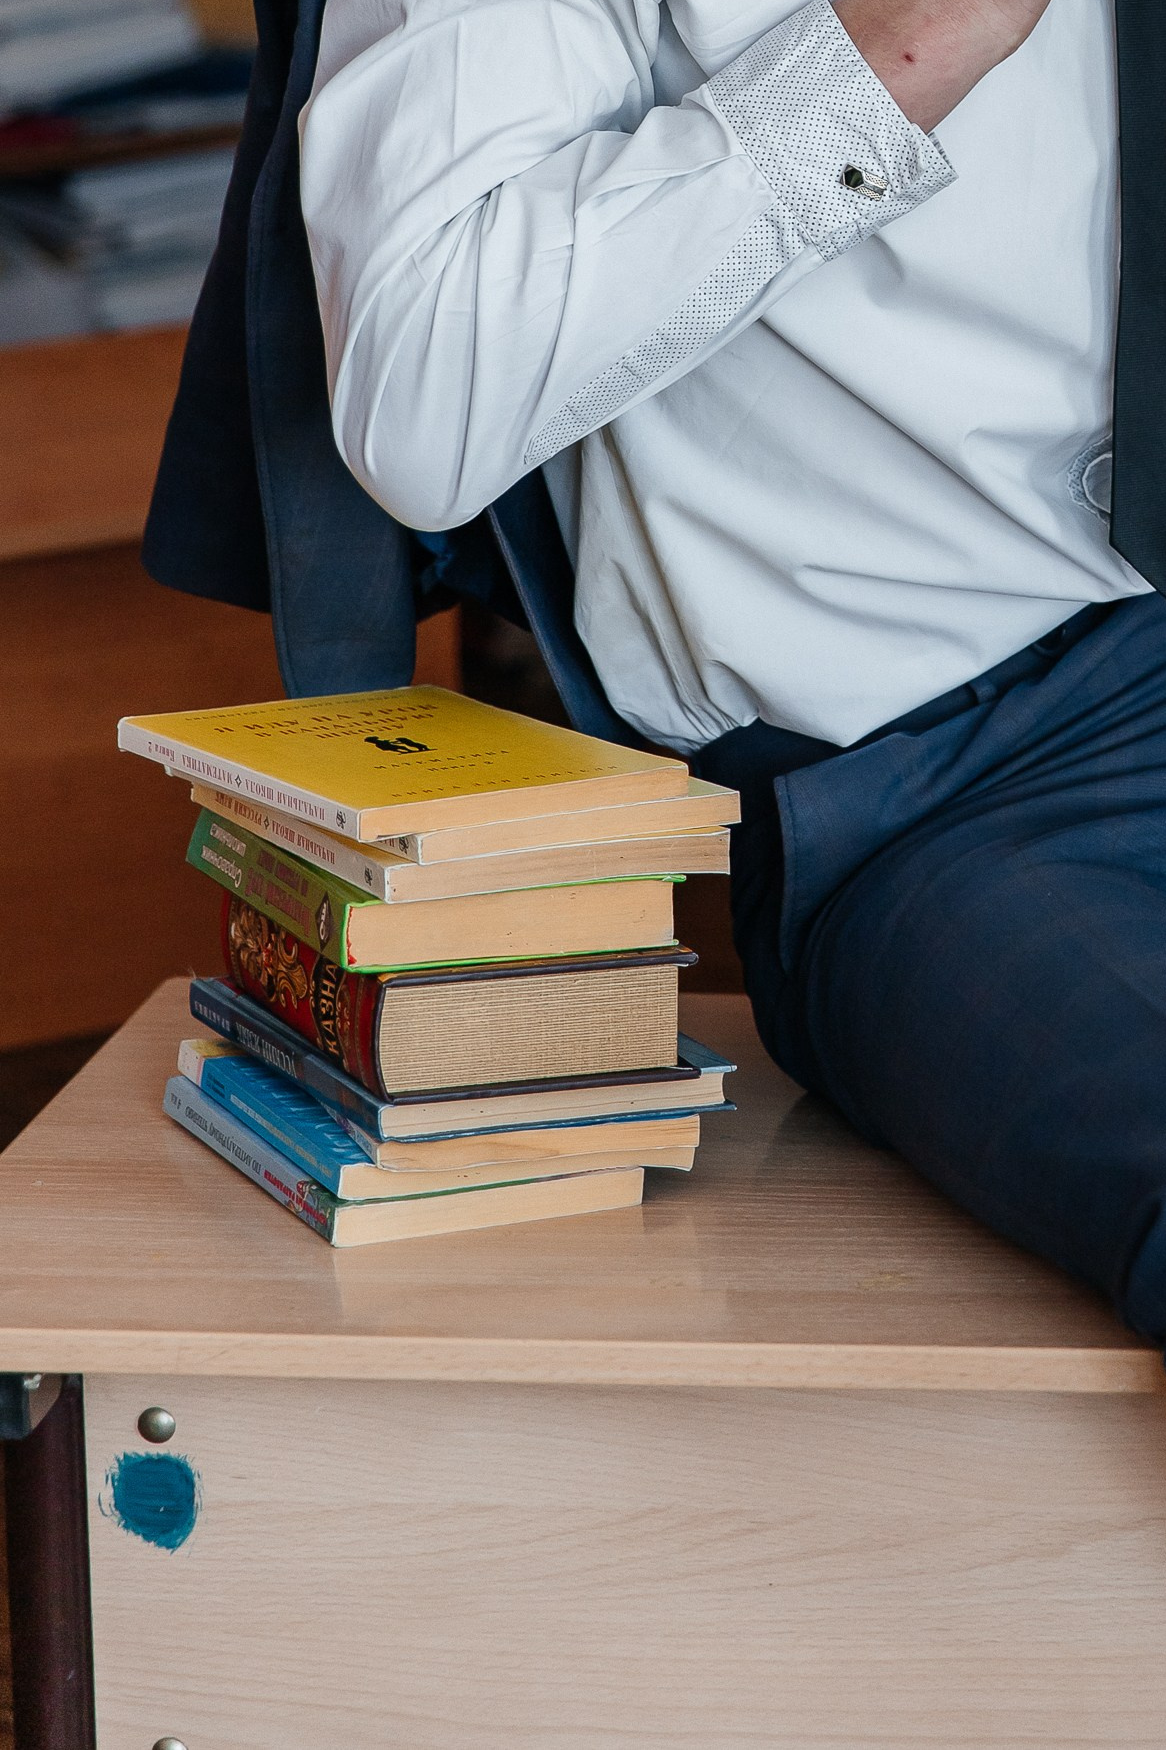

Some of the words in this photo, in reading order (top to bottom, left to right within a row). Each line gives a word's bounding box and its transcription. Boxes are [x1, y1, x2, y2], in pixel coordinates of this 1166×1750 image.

[280, 713, 437, 736] НАЧАЛЬНУЮ
[311, 712, 353, 724] НА
[359, 702, 440, 718] УРОК
[314, 723, 406, 740] ШКОЛУ
[153, 743, 176, 763] Книга
[373, 749, 511, 771] МАТЕМАТИКА
[181, 754, 234, 786] МАТЕМАТИКА
[244, 778, 275, 802] ШКОЛА
[233, 800, 263, 824] РУССКИЙ
[276, 790, 326, 822] НАЧАЛЬНАЯ
[271, 820, 296, 845] ШКОЛА
[297, 833, 336, 865] НАЧАЛЬНАЯ
[319, 962, 340, 1056] КАЗНА
[261, 1038, 299, 1079] УССКИЙ
